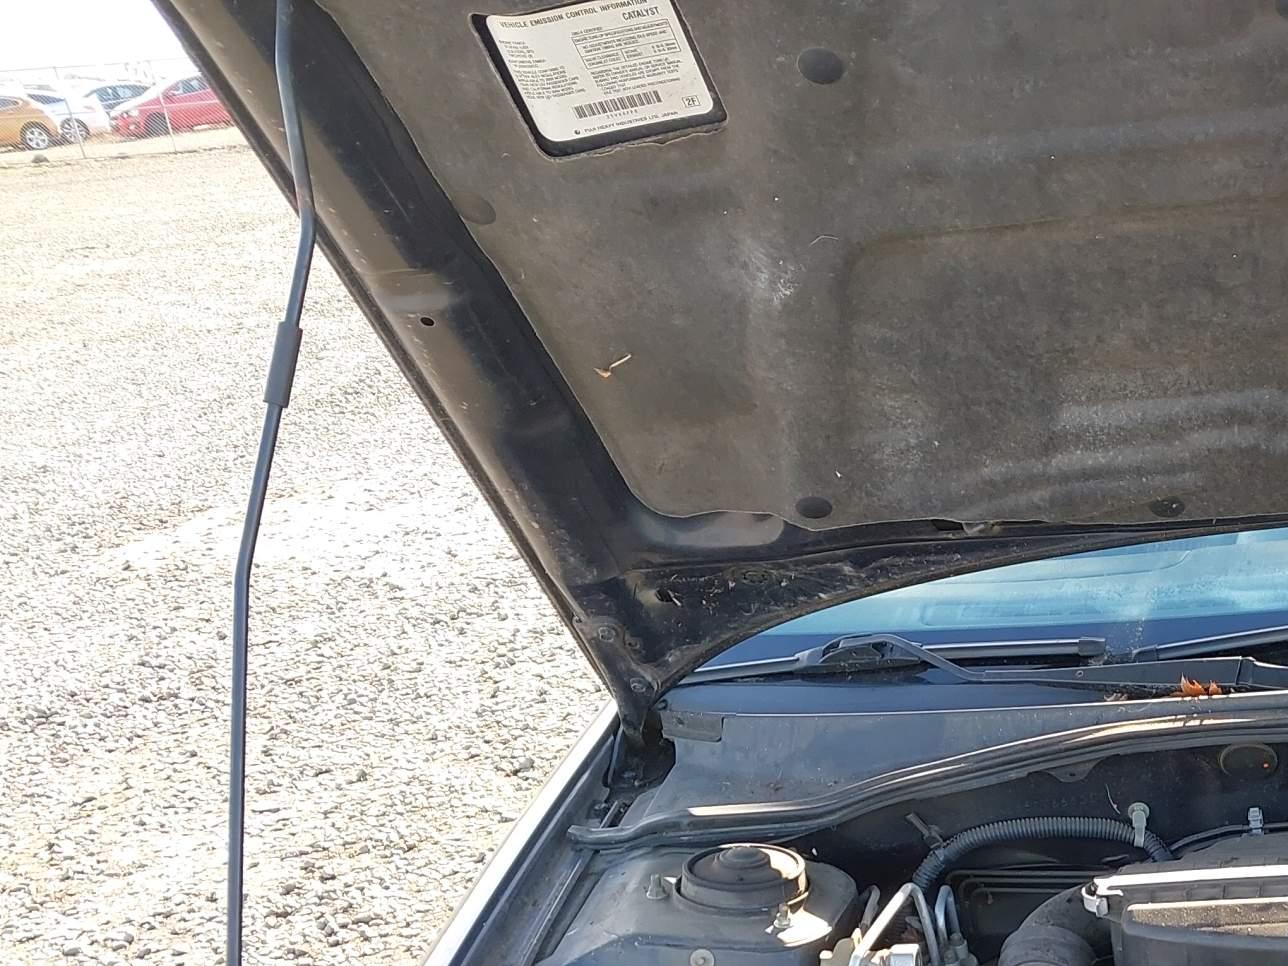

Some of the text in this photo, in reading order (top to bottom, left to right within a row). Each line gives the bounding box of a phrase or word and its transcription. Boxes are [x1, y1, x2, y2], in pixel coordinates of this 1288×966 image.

[530, 15, 564, 26] EMISSION
[565, 8, 598, 19] CONTROL
[600, 0, 648, 11] INFORMATION
[622, 6, 661, 21] CATALYST
[685, 96, 697, 106] 2F
